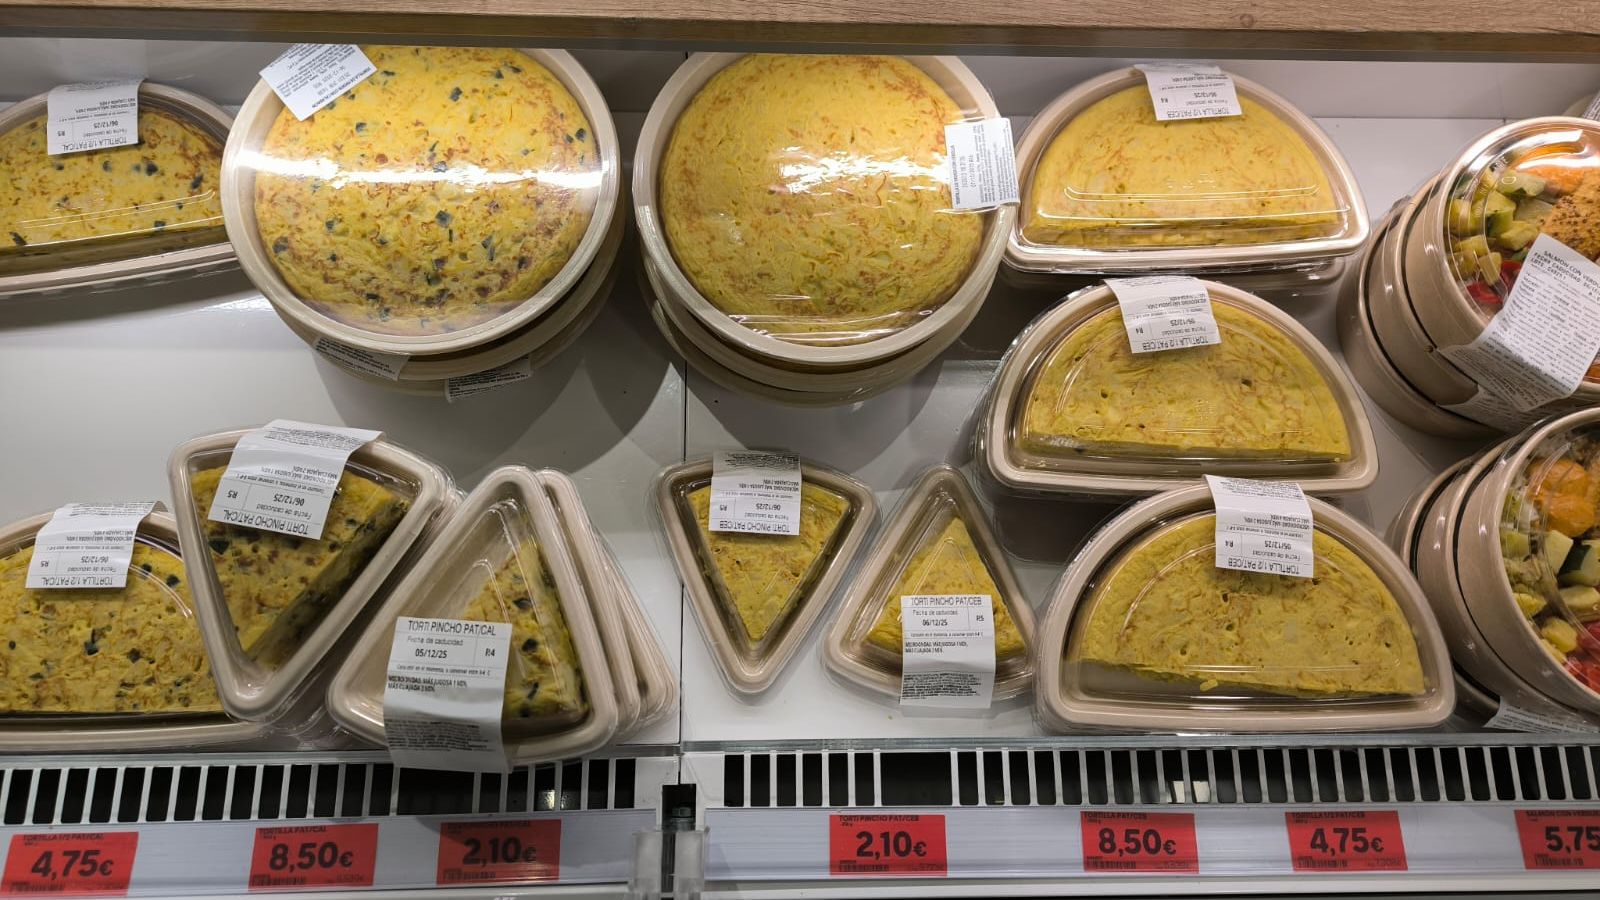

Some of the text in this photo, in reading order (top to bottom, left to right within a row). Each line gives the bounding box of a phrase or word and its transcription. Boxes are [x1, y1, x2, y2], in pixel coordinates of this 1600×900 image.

[227, 489, 237, 498] R5
[273, 493, 304, 506] 06/12/25
[222, 509, 308, 534] TORTI PINCHO PAT/CAL
[719, 520, 789, 532] TORTI PINCHO PAT/CEB
[1227, 557, 1300, 574] TORTILLA 1/2 PAT/CEB
[41, 576, 112, 585] TORTILLA 1/2 PAT/CAL
[911, 597, 981, 605] TORTI PINCHO PAT/CEB
[408, 620, 496, 636] TORTI PINCHO PAT/CAL
[415, 648, 447, 658] 05/12/25
[485, 648, 495, 656] R4
[23, 833, 58, 842] TORTILLA
[259, 826, 292, 834] TORTILLA
[855, 830, 926, 860] 2,10€
[1099, 828, 1176, 857] 8,50€
[1310, 826, 1384, 857] 4,75€
[1545, 826, 1600, 854] 5,75
[269, 842, 352, 873] 8,50€
[462, 838, 536, 867] 2,10€
[31, 850, 113, 881] 4,75€
